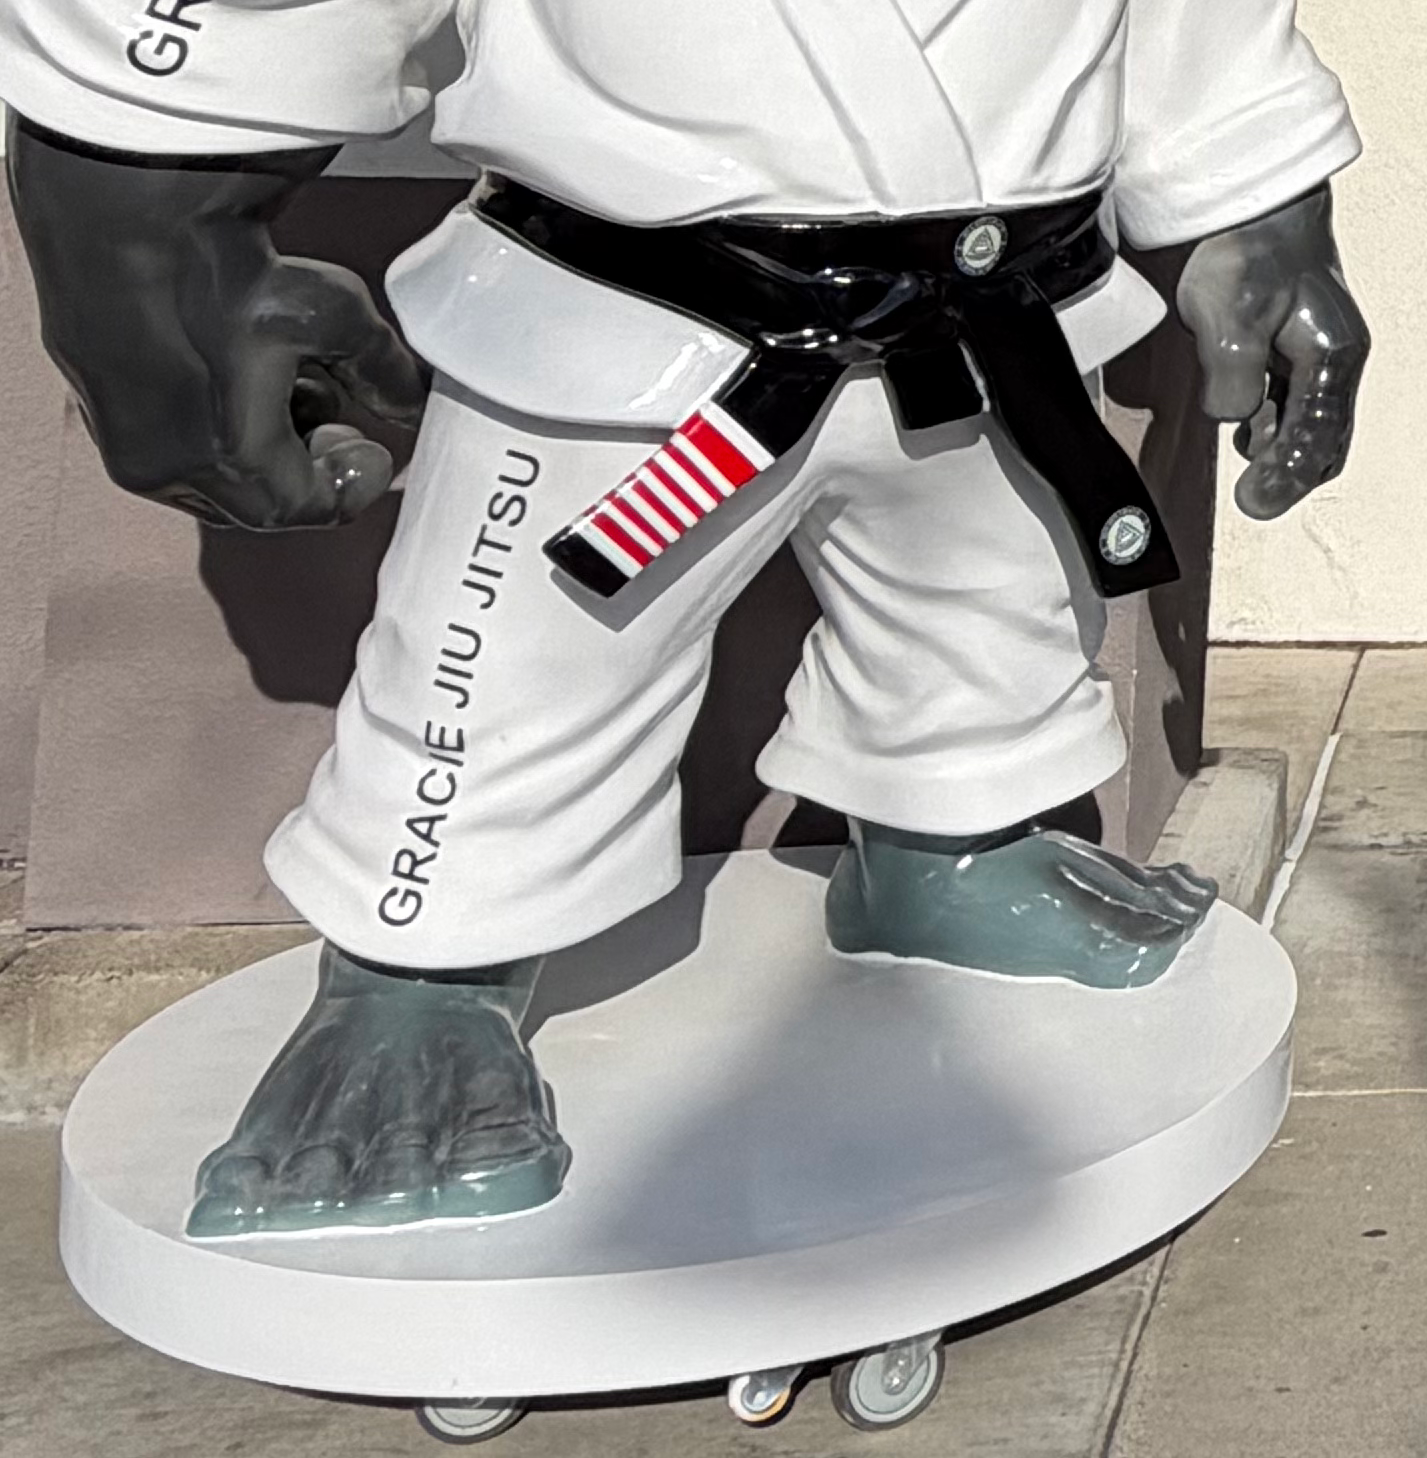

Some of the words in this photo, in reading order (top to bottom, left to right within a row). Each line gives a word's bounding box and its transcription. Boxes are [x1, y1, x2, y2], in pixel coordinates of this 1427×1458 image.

[378, 720, 465, 927] GRACIE
[433, 622, 482, 710] JIU
[462, 449, 540, 610] JITSU
